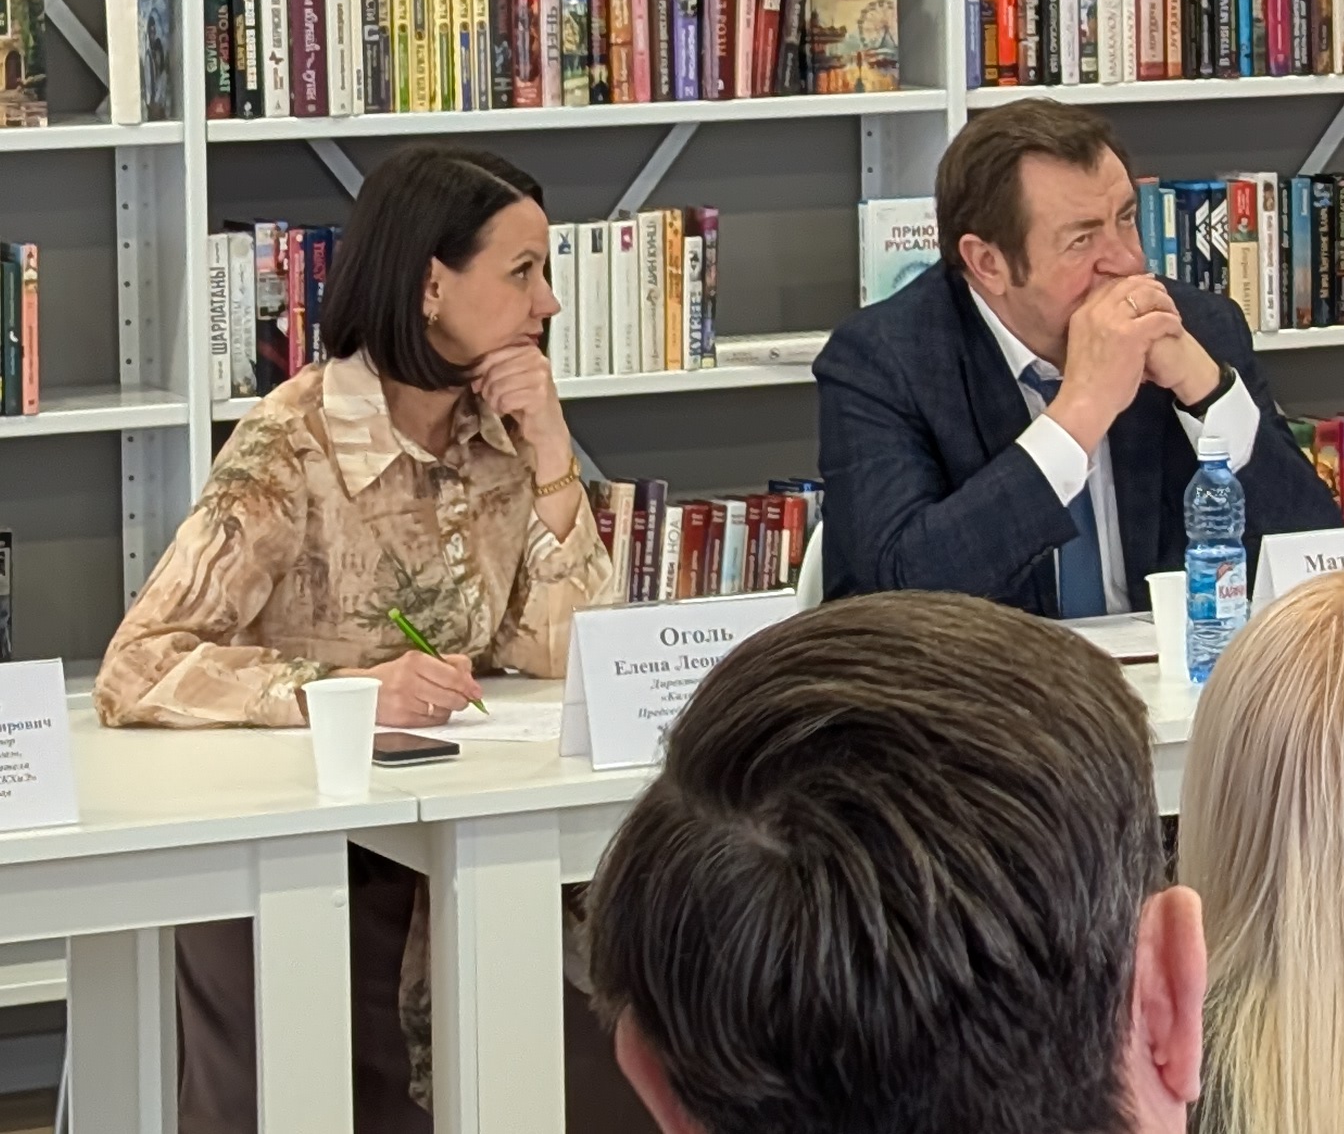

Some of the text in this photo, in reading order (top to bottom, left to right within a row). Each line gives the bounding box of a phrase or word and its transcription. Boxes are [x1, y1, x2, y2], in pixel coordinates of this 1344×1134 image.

[884, 238, 940, 252] РУСАЛК
[210, 266, 226, 355] ШАРЛАТАНЫ
[660, 627, 733, 647] Оголь
[614, 654, 725, 676] Елена Леон
[650, 679, 701, 690] Директо
[0, 718, 52, 735] ирович
